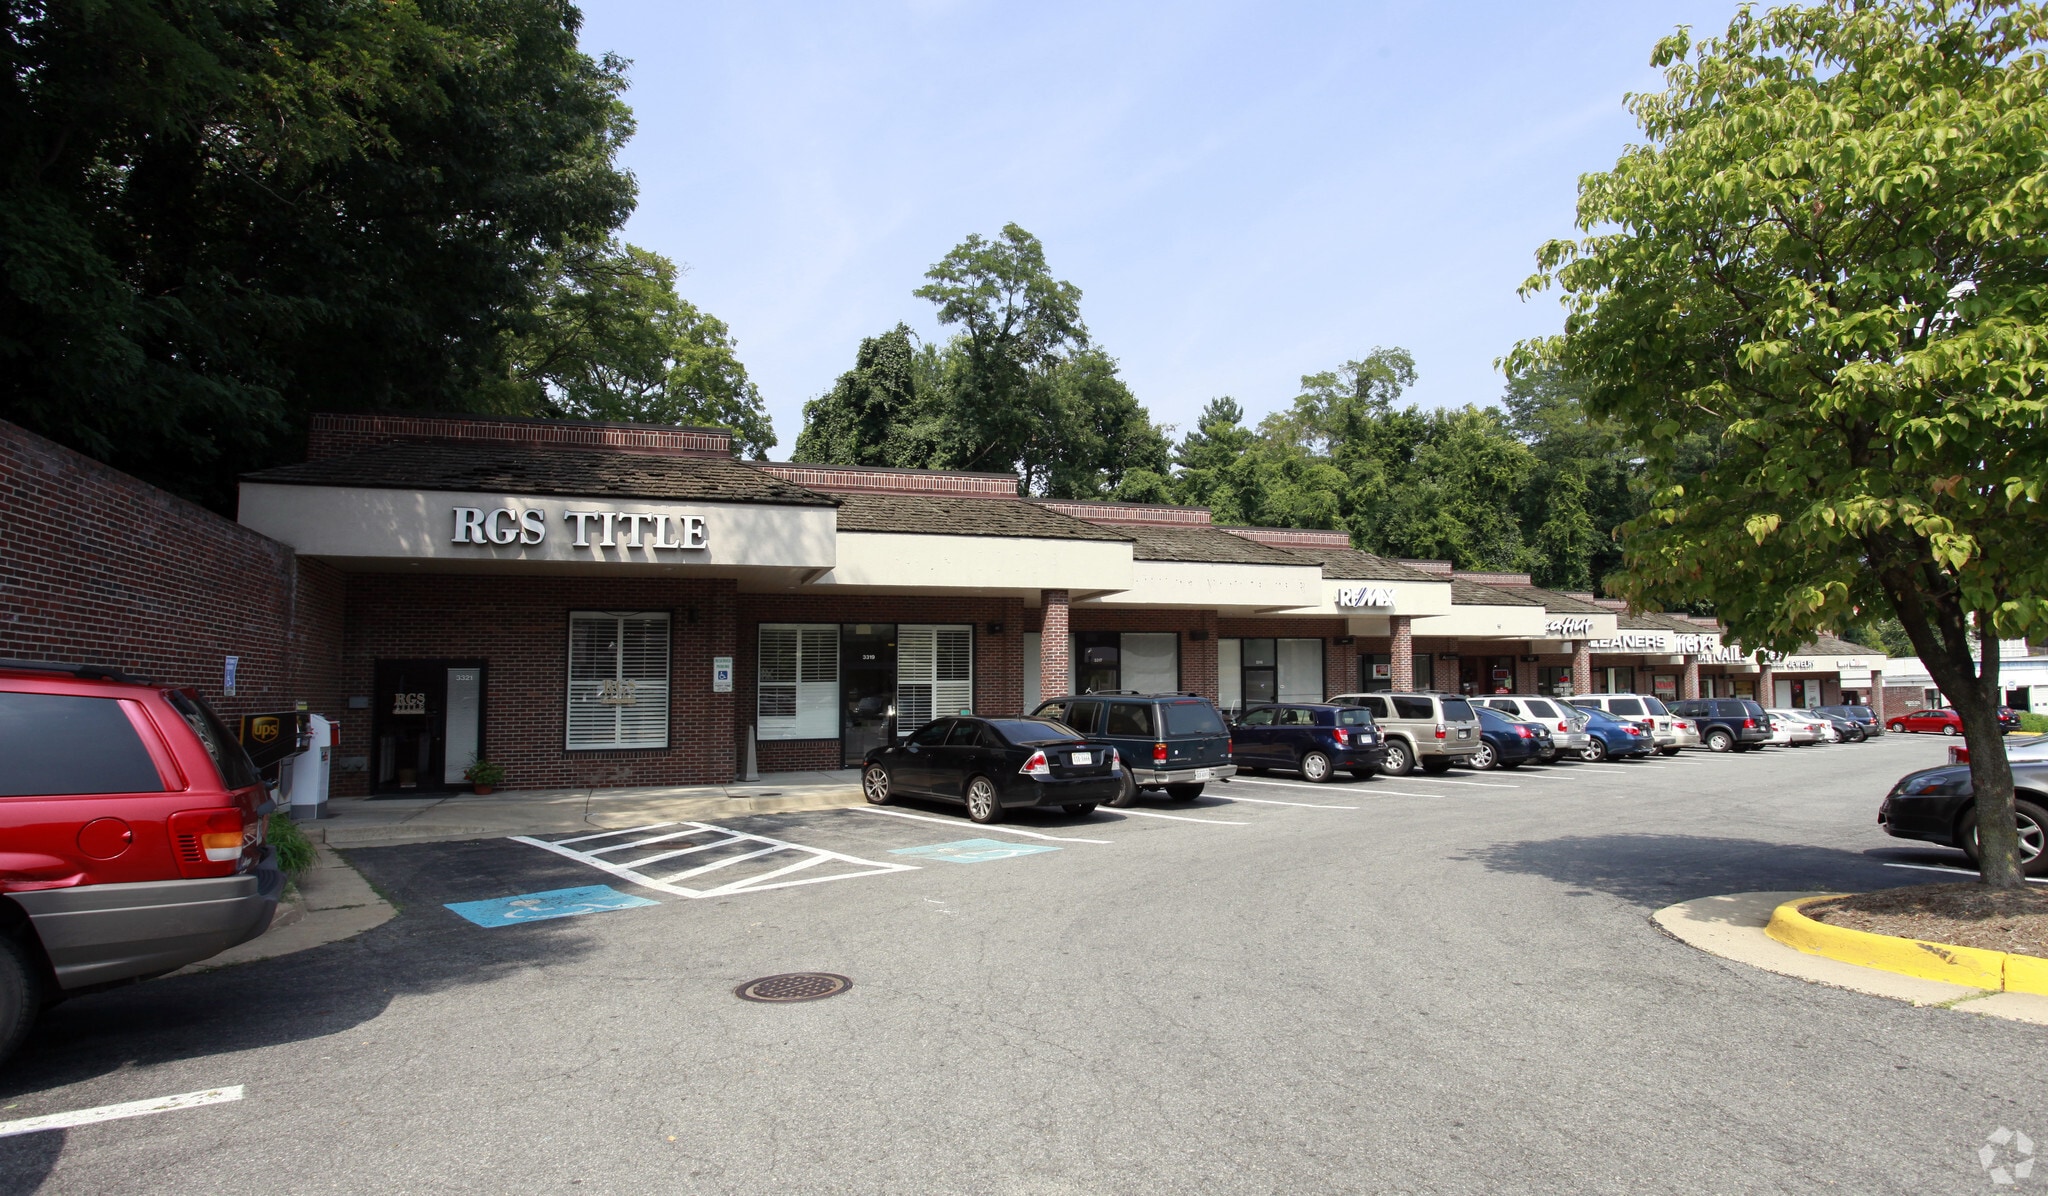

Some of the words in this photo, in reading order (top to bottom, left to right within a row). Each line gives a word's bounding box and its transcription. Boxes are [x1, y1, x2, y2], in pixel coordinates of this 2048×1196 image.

[451, 507, 546, 545] RGS
[564, 510, 708, 549] TITLE
[1588, 635, 1666, 648] LEANERS
[394, 693, 425, 705] RGS
[254, 723, 278, 739] ups
